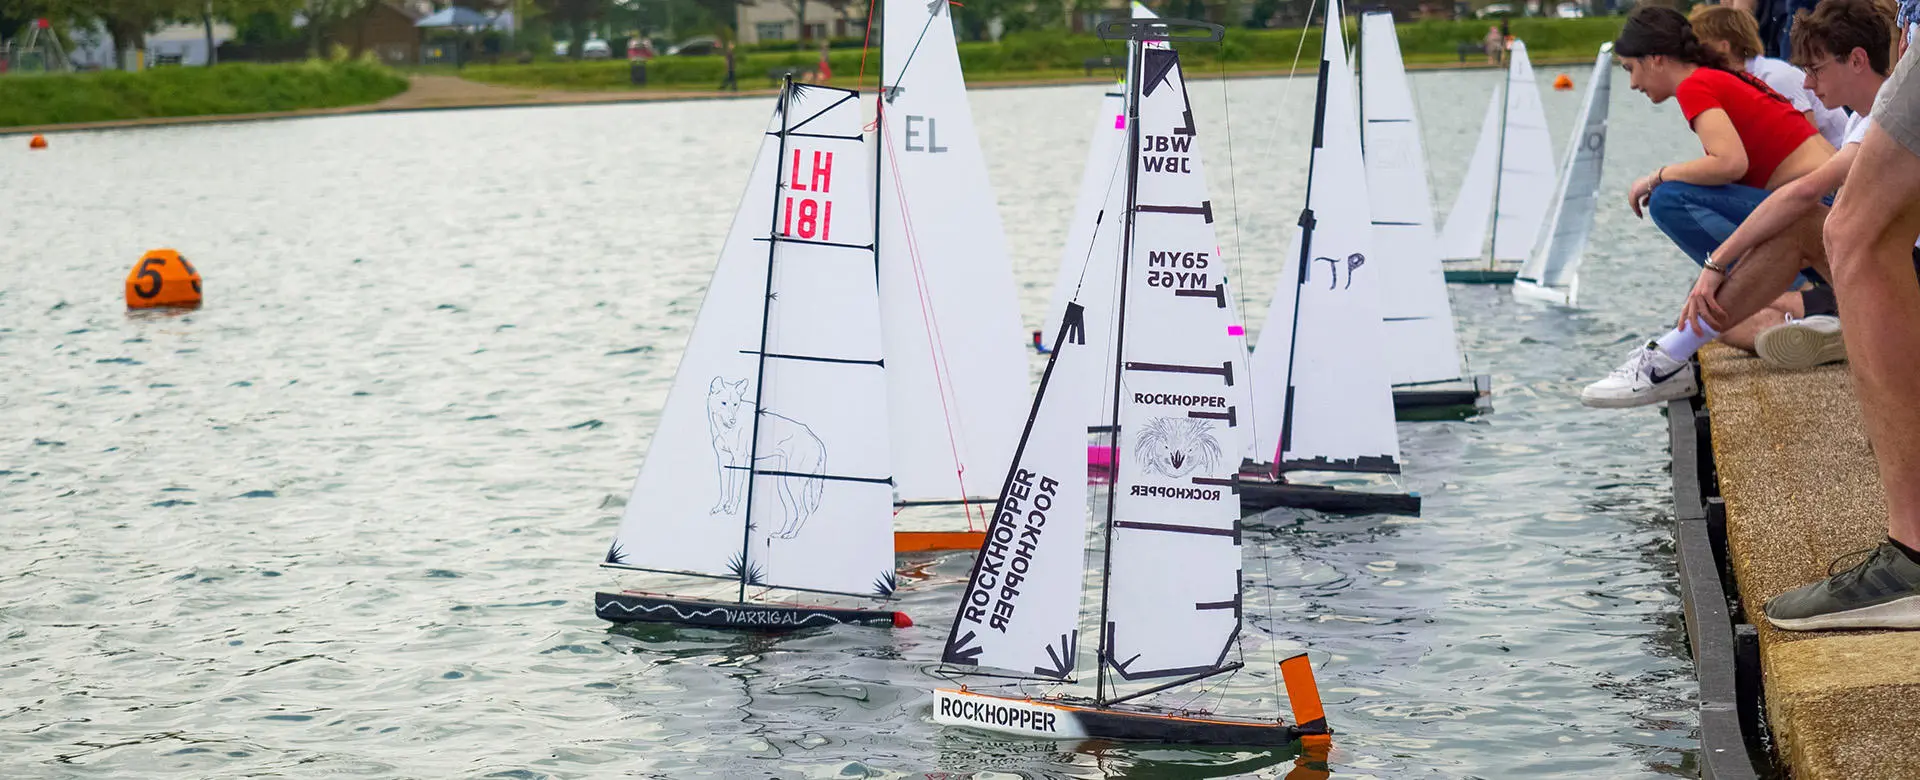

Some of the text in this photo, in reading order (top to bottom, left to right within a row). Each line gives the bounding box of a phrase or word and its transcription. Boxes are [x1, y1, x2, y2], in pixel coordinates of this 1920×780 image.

[905, 115, 948, 153] EL
[1143, 135, 1192, 153] JBW
[791, 149, 833, 193] LH
[784, 197, 832, 241] 181
[134, 258, 166, 299] 5
[1149, 251, 1209, 269] MY65
[1314, 253, 1365, 290] TP
[1134, 392, 1226, 408] ROCKHOPPER
[964, 468, 1036, 624] ROCKHOPPER
[726, 610, 801, 625] WARRIGAL
[941, 697, 1056, 732] ROCKHOPPER
